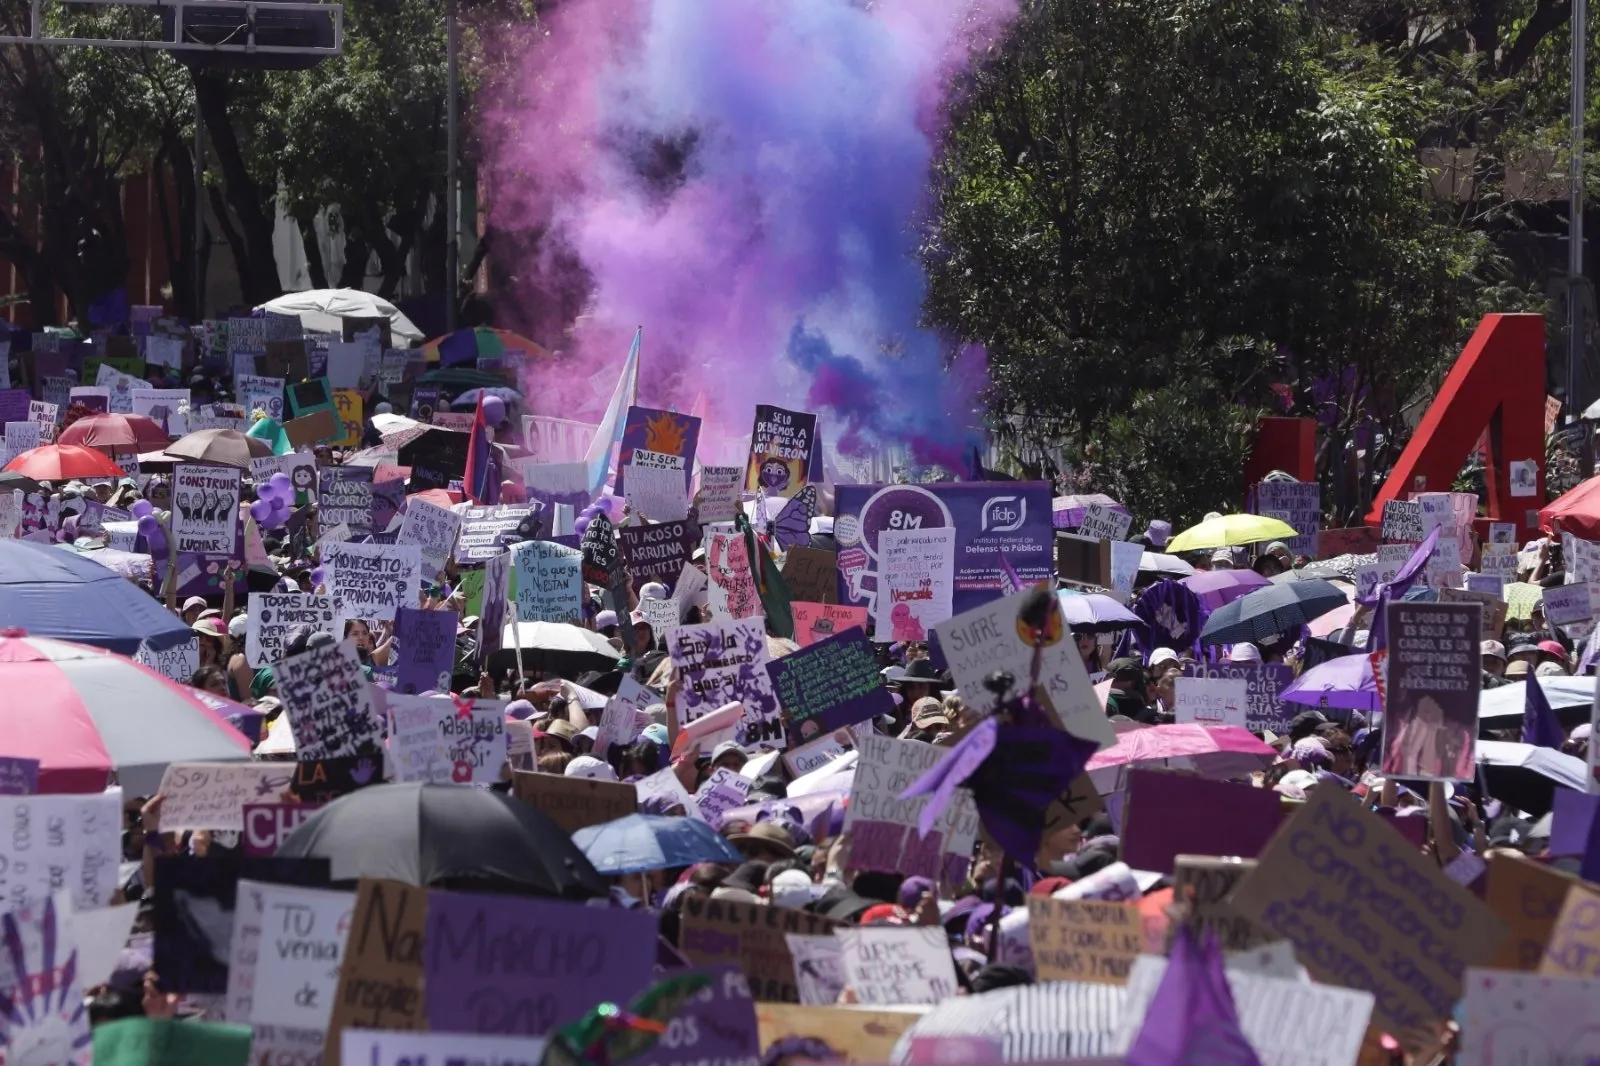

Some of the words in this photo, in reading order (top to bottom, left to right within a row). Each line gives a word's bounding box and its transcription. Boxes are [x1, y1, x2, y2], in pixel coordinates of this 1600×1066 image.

[773, 412, 781, 422] SE
[783, 415, 791, 425] LO
[757, 421, 794, 437] DEBEMOS
[798, 428, 807, 439] A
[758, 433, 770, 442] LAS
[773, 435, 790, 446] QUE
[792, 438, 805, 449] NO
[636, 450, 656, 461] QUE
[658, 453, 677, 465] SER
[754, 444, 808, 460] VOLVIERON
[179, 475, 238, 490] CONSTRUIR
[329, 481, 369, 495] CANSAS
[318, 509, 373, 524] NOSOTRAS
[992, 506, 1017, 524] ifdp
[1090, 504, 1101, 516] NO
[889, 510, 923, 529] 8M
[624, 532, 637, 544] TU
[643, 524, 684, 542] ACOSO
[1023, 536, 1034, 544] de
[179, 538, 222, 552] LUCHAR
[631, 542, 684, 562] ARRUINA
[1011, 542, 1043, 553] Pública
[643, 558, 683, 576] OUTFIT
[335, 580, 386, 591] NECESITO
[259, 595, 301, 608] TODAS
[306, 596, 329, 609] LAS
[277, 609, 318, 623] MADRES
[1416, 613, 1451, 623] PODER
[1453, 613, 1469, 624] NO
[950, 612, 1003, 652] SUFRE
[1419, 625, 1448, 636] SOLO
[1450, 626, 1466, 636] UN
[259, 638, 281, 648] VER
[157, 652, 187, 665] PARA
[745, 716, 783, 743] 8M
[298, 763, 328, 785] LA
